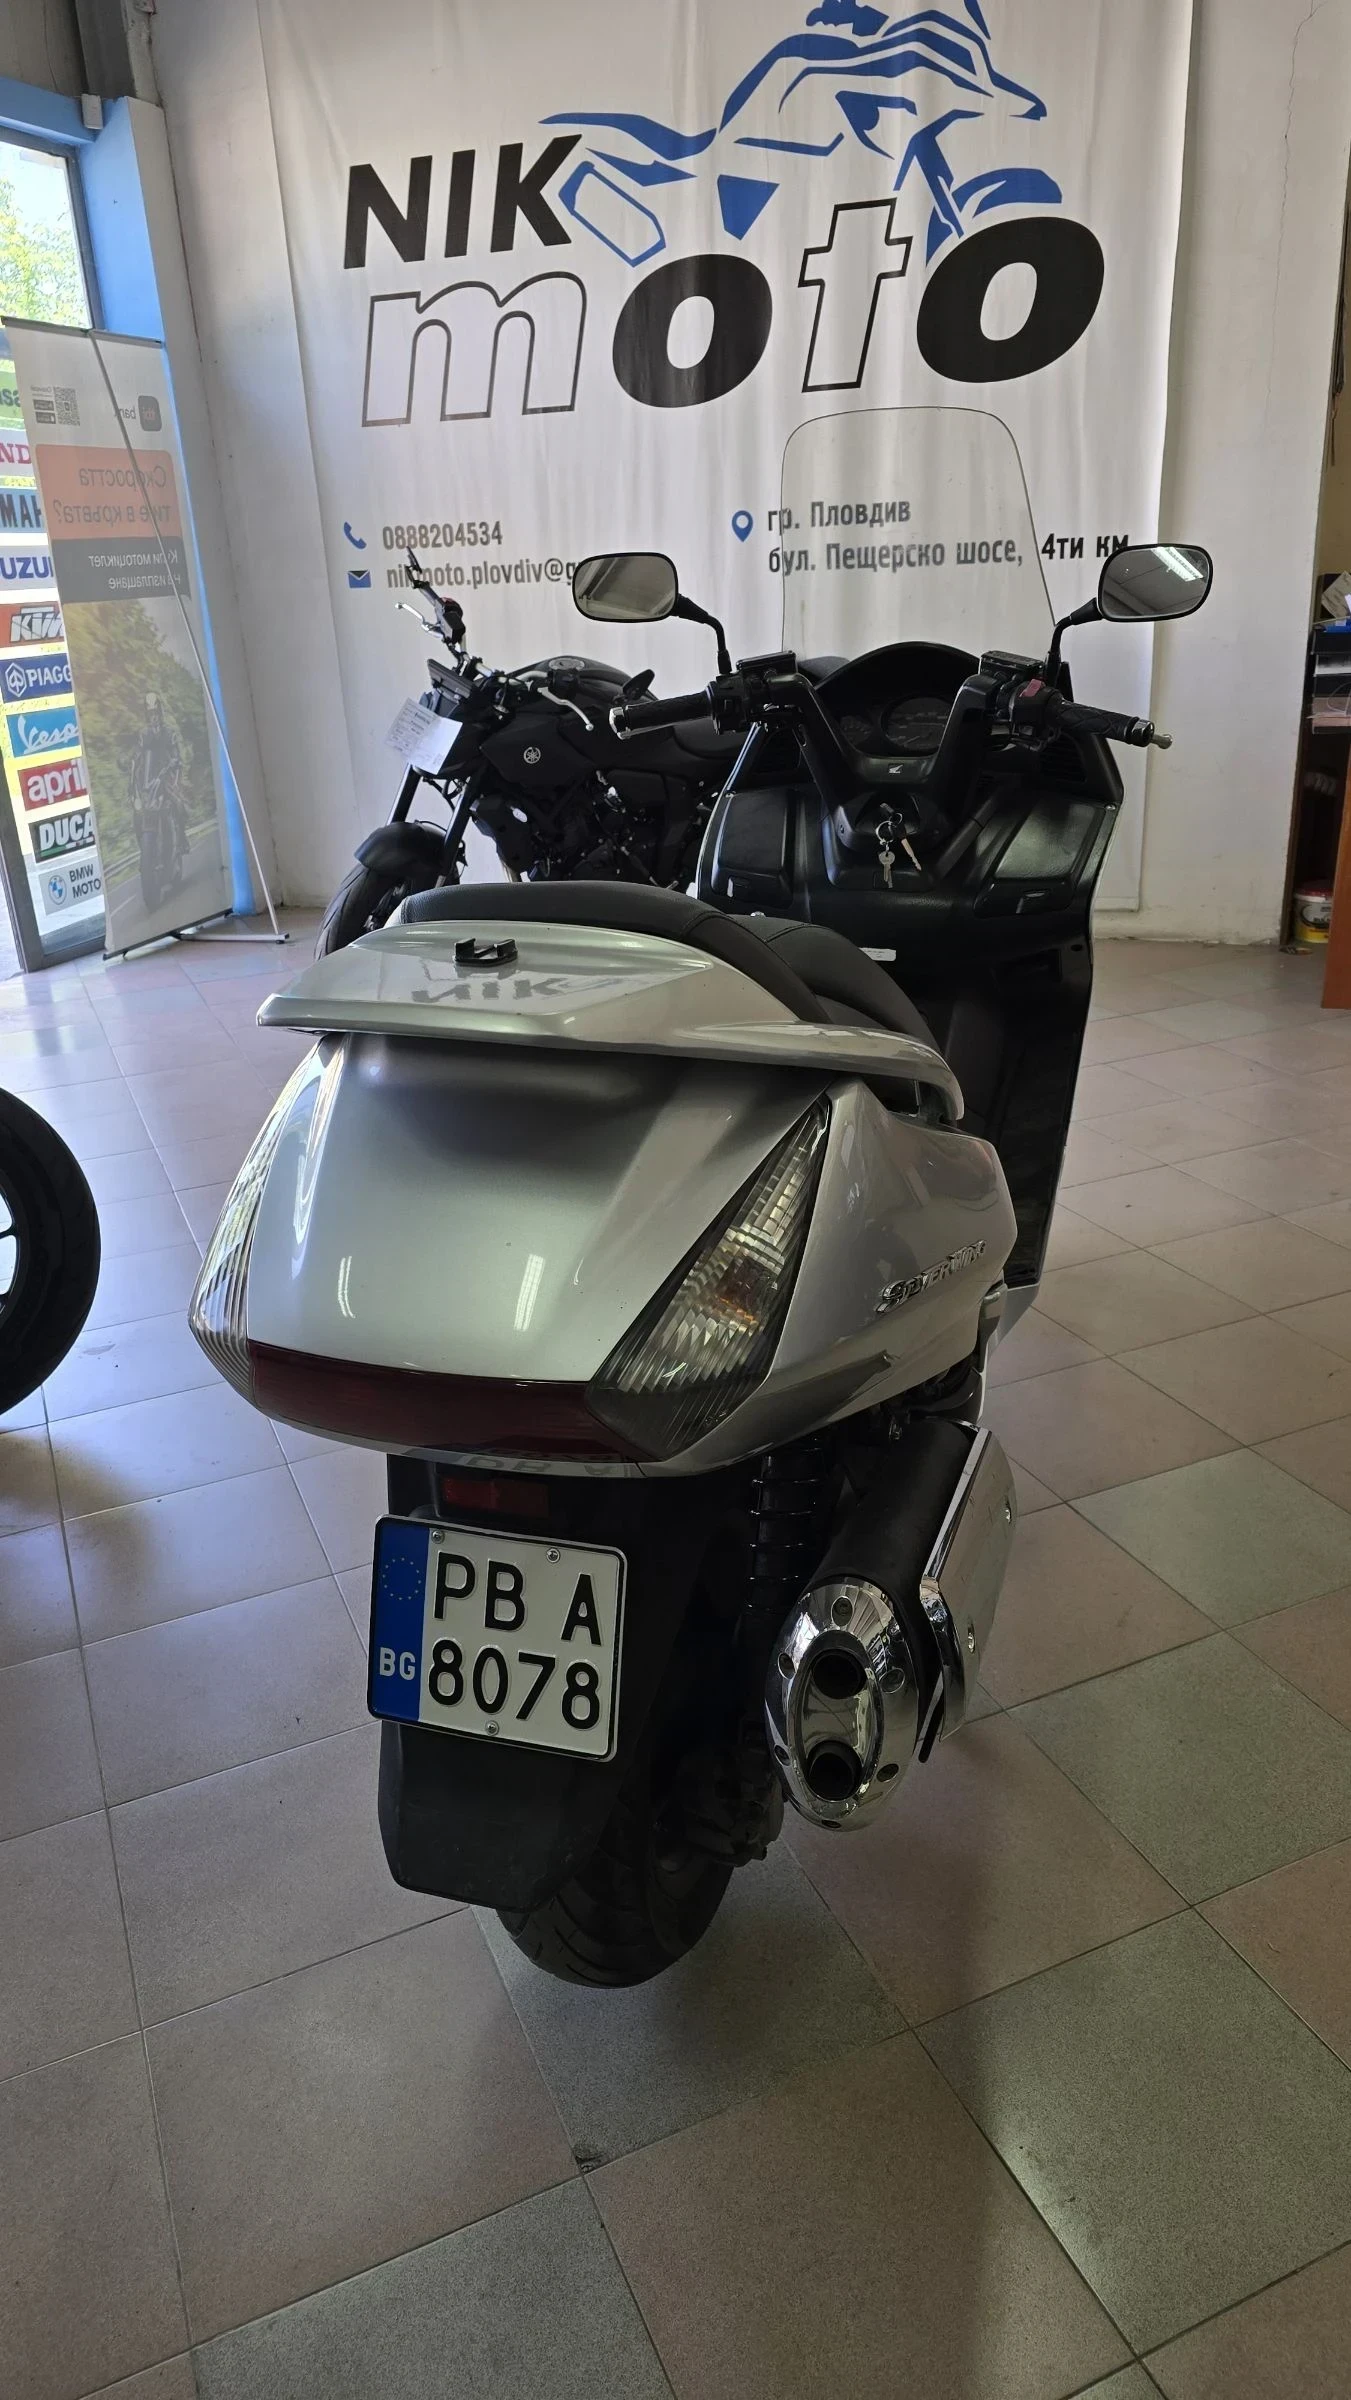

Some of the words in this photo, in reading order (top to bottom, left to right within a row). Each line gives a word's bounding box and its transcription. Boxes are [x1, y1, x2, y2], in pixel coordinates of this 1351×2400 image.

[343, 133, 583, 270] NIK
[361, 195, 1105, 428] moto
[382, 520, 503, 550] 0888204534
[767, 508, 800, 536] гр.
[810, 501, 911, 532] Пловдив
[0, 557, 54, 579] UZU
[768, 546, 816, 576] бул.
[826, 542, 945, 574] Пещерско
[956, 537, 1023, 567] шосе,
[1041, 533, 1084, 560] 4ти
[17, 714, 80, 755] Vesp
[69, 864, 94, 883] BMW
[72, 878, 102, 898] MOTO
[434, 1551, 526, 1631] PB
[560, 1573, 602, 1647] A
[379, 1646, 416, 1681] BG
[428, 1638, 600, 1730] 8078
